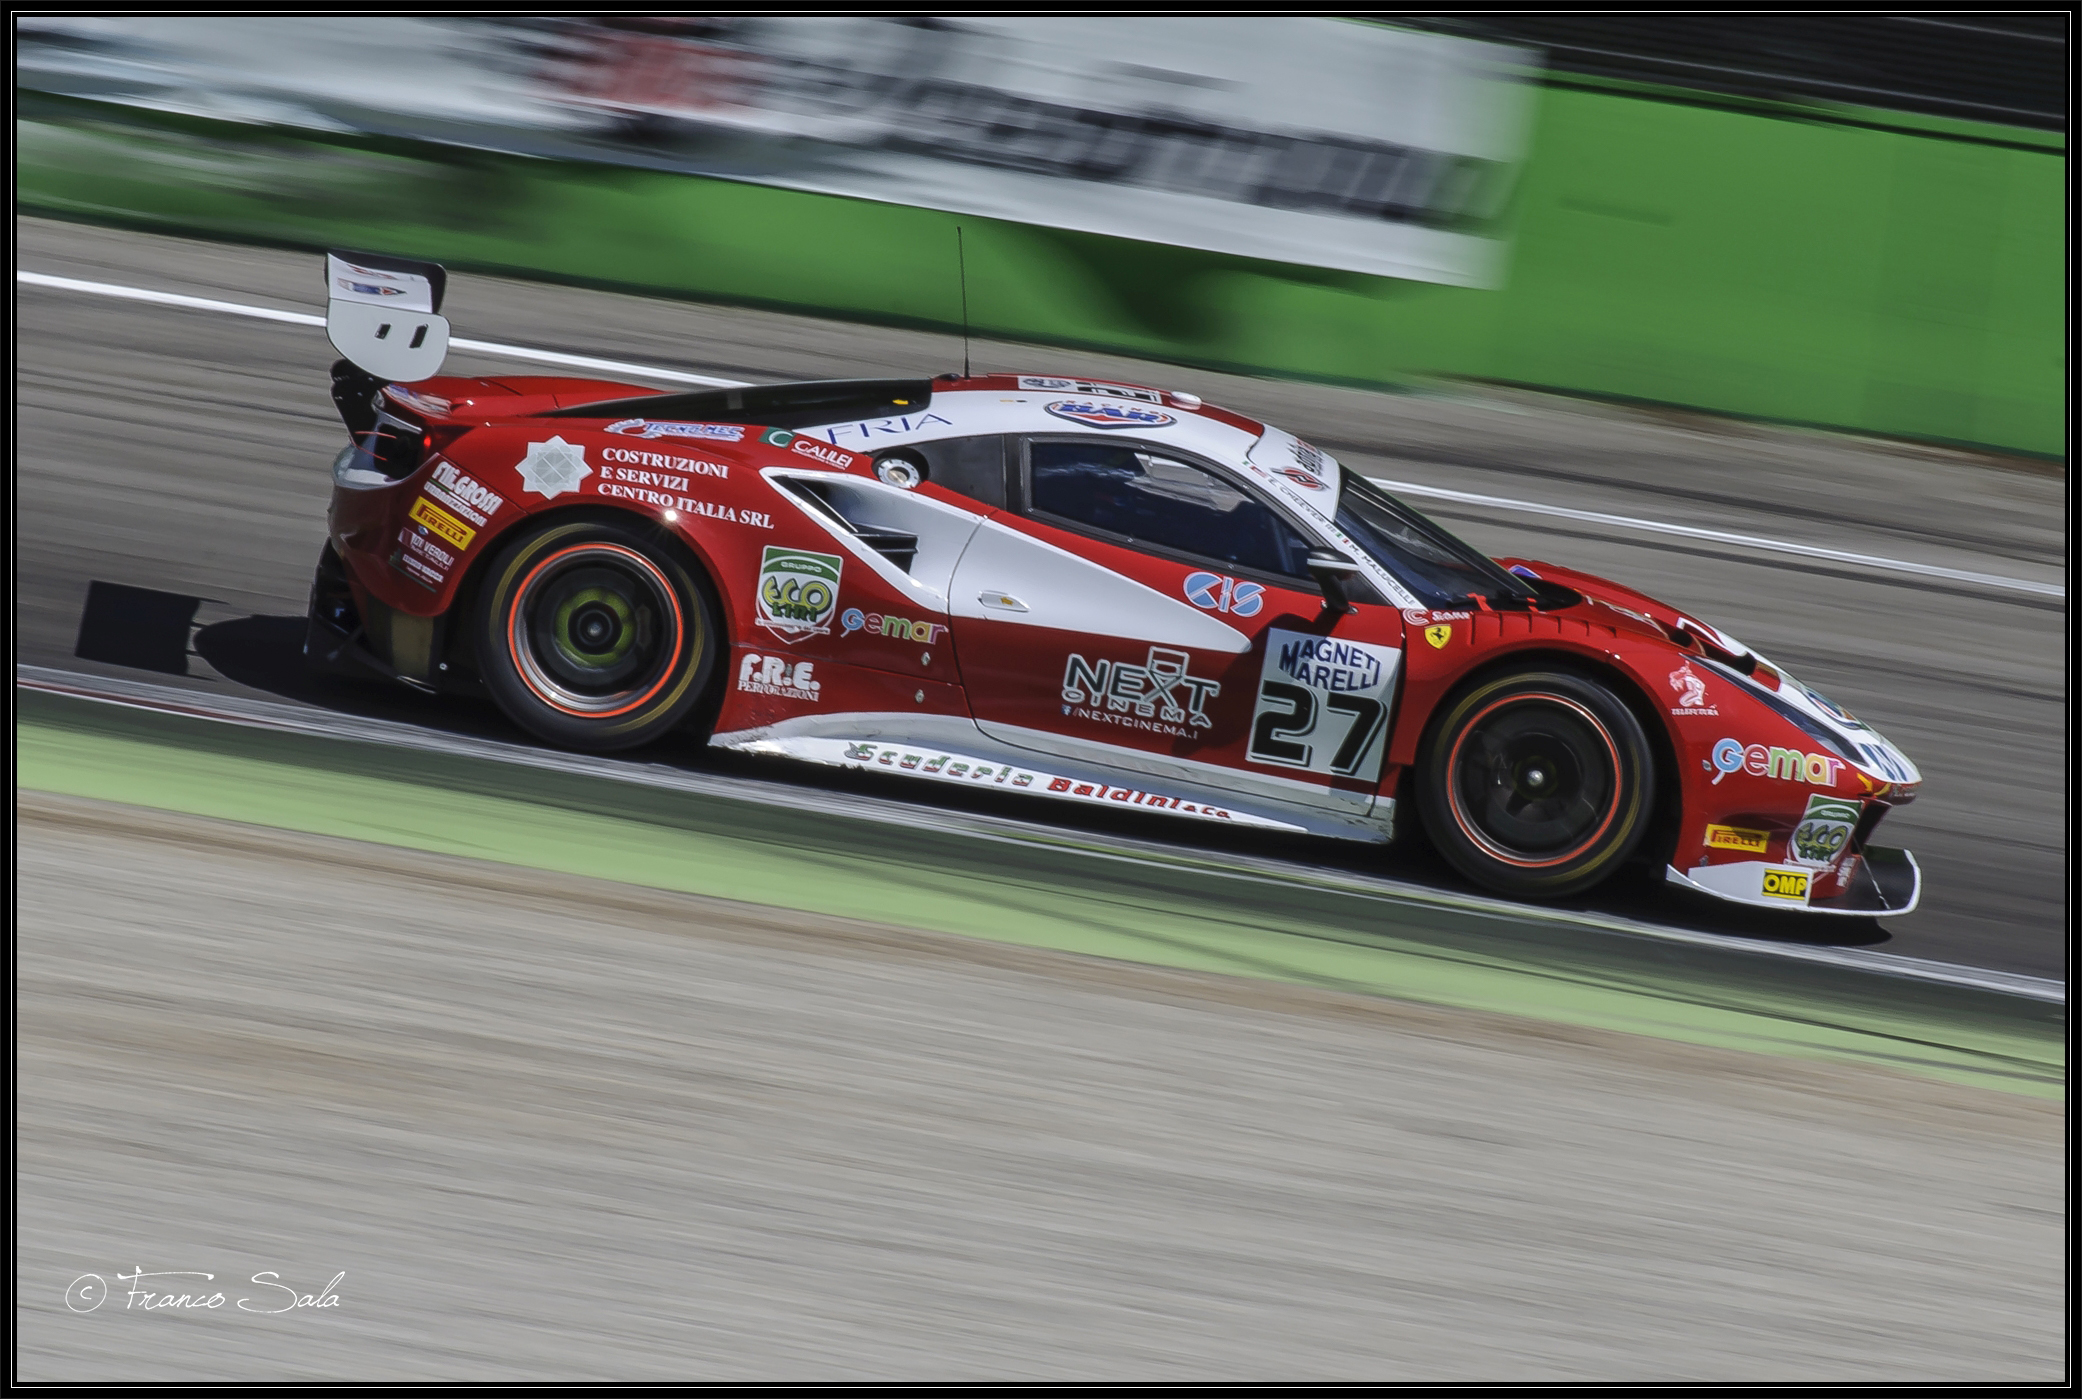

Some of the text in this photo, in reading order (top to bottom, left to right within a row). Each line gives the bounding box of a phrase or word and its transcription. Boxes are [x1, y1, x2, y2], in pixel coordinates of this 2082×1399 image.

[827, 413, 953, 445] FRIA
[600, 466, 690, 492] E SERVIZI
[602, 447, 729, 479] COSTRUZIONI
[415, 503, 468, 543] PIRELLI
[597, 483, 775, 529] CENTRO ITALIA SRL
[840, 608, 949, 645] Gemar
[1279, 639, 1382, 680] MAGNETI
[1280, 657, 1380, 692] MARELLI
[1062, 646, 1220, 714] NEXT
[1251, 679, 1388, 776] 27
[858, 743, 1034, 787] Scuderia
[1048, 777, 1183, 811] Baldini
[1711, 738, 1846, 787] Gemar
[1711, 829, 1763, 848] PIRELLI
[1764, 874, 1807, 895] OMP
